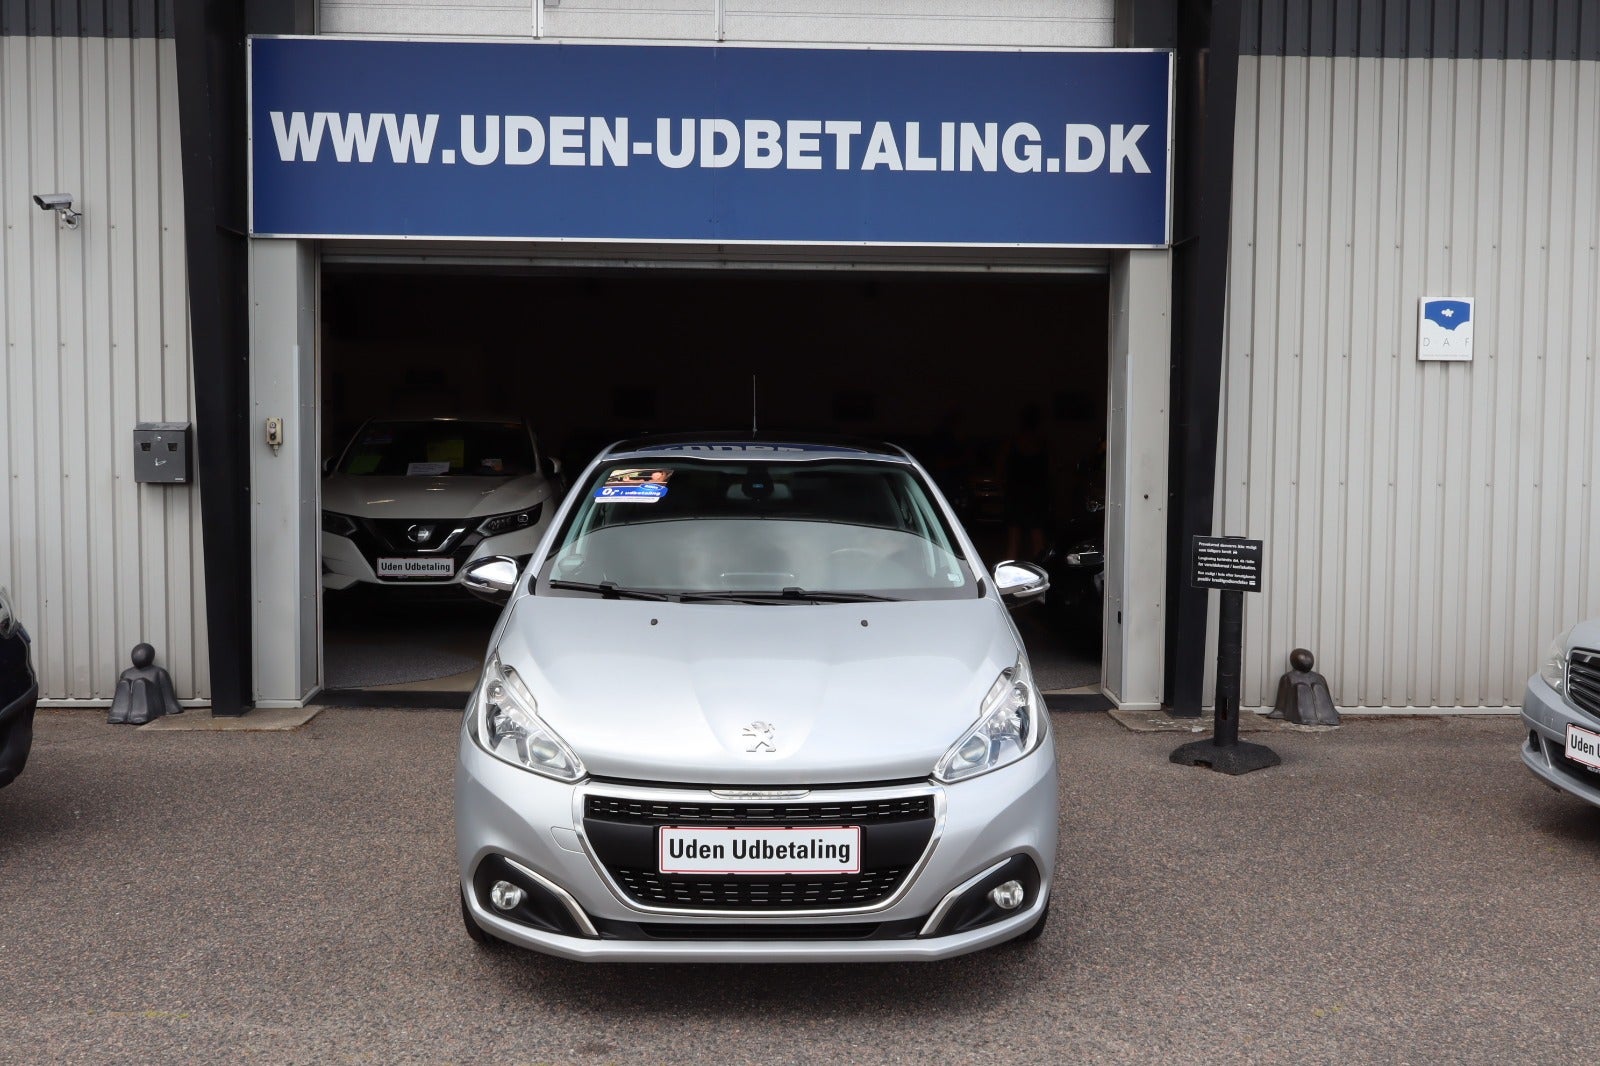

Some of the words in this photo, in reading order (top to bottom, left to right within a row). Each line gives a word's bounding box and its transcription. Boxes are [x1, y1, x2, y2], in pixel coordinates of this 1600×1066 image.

[270, 111, 1152, 174] WWW.UDEN-UDBETALING.DK
[381, 562, 403, 571] Uden
[404, 562, 451, 573] Udbetaling
[1571, 734, 1594, 755] Uden
[669, 838, 725, 859] Uden
[732, 838, 850, 864] Udbetaling
